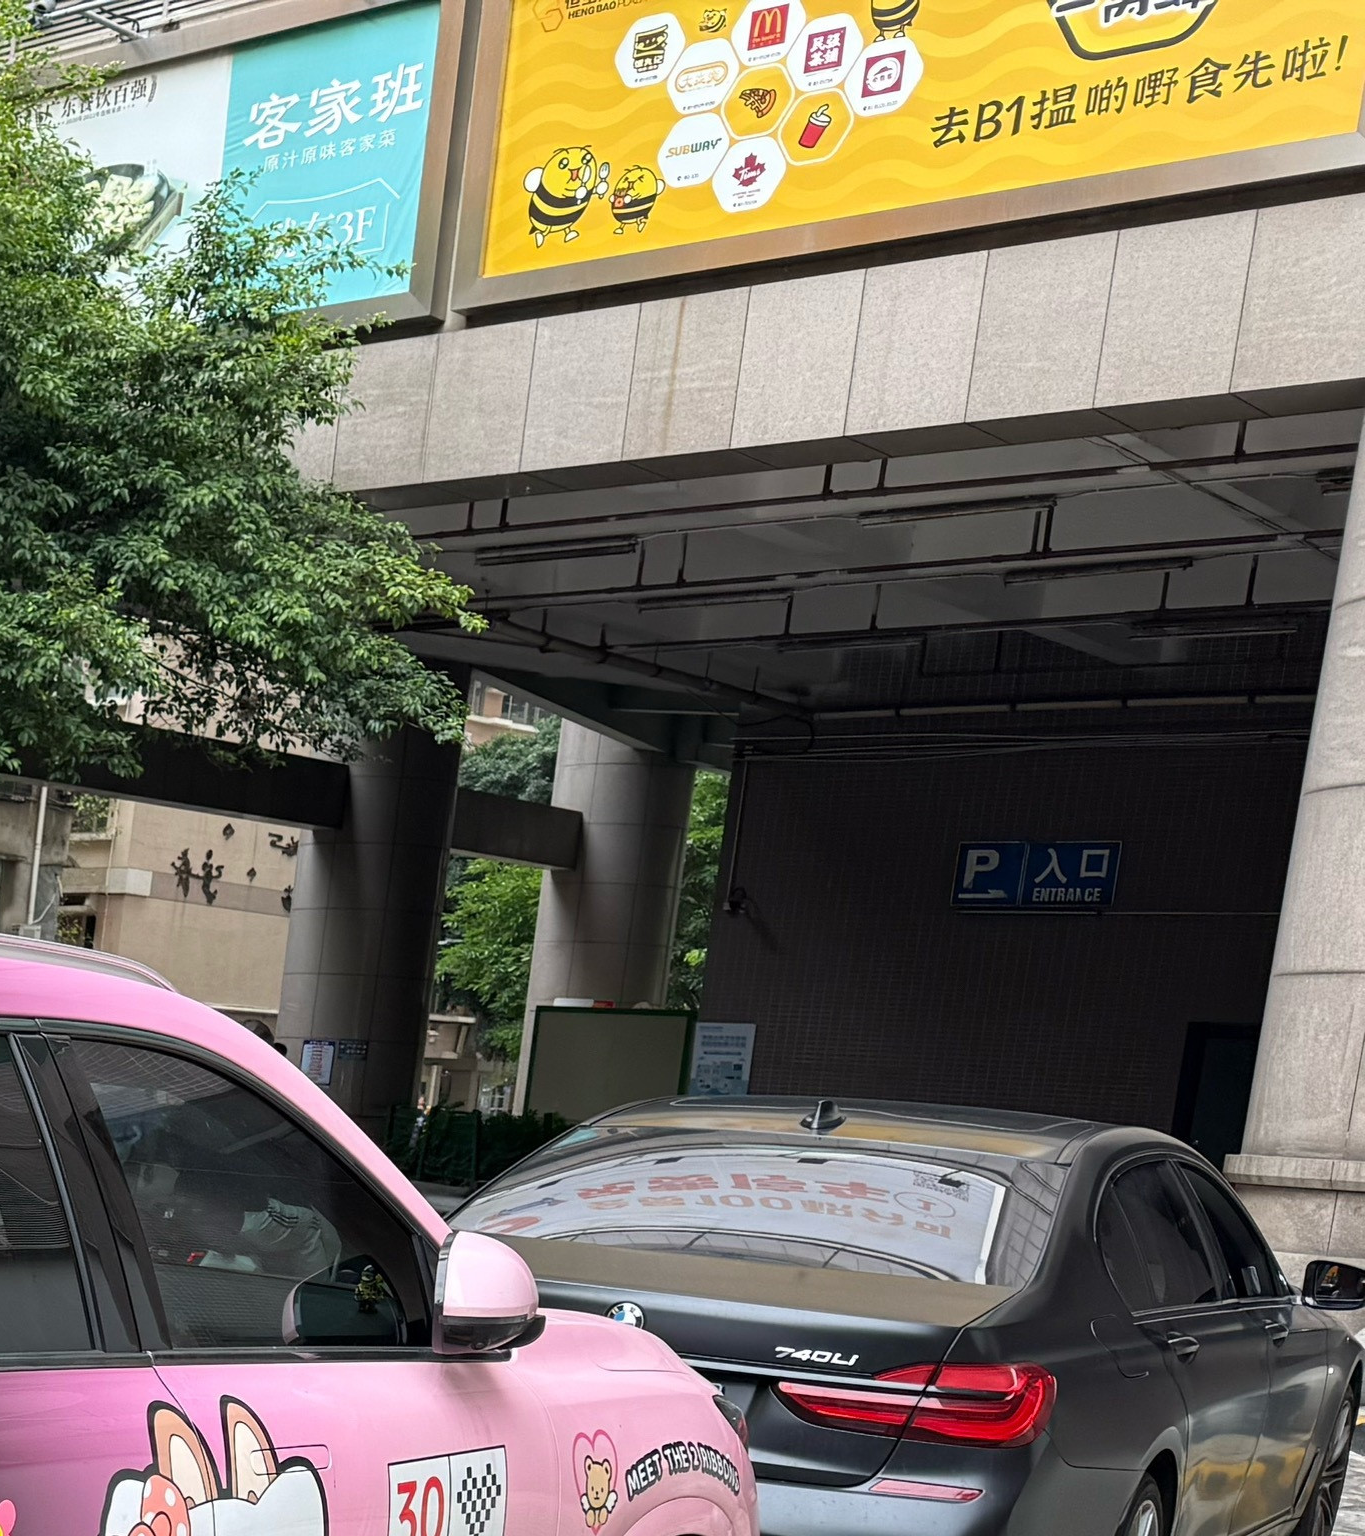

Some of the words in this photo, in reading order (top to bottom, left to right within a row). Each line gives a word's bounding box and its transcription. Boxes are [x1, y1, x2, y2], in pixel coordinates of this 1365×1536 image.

[567, 6, 595, 19] HENG
[596, 1, 617, 13] BAO
[242, 62, 425, 150] 客家班
[263, 128, 397, 174] 原汁原味客家菜
[665, 138, 723, 159] SUBWAY
[962, 848, 1000, 889] P
[1033, 848, 1111, 884] 入口
[1031, 887, 1103, 902] ENTRANCE
[625, 1449, 663, 1501] MEET
[662, 1442, 690, 1475] THE
[688, 1442, 701, 1470] 2
[698, 1442, 740, 1496] RIBBONS
